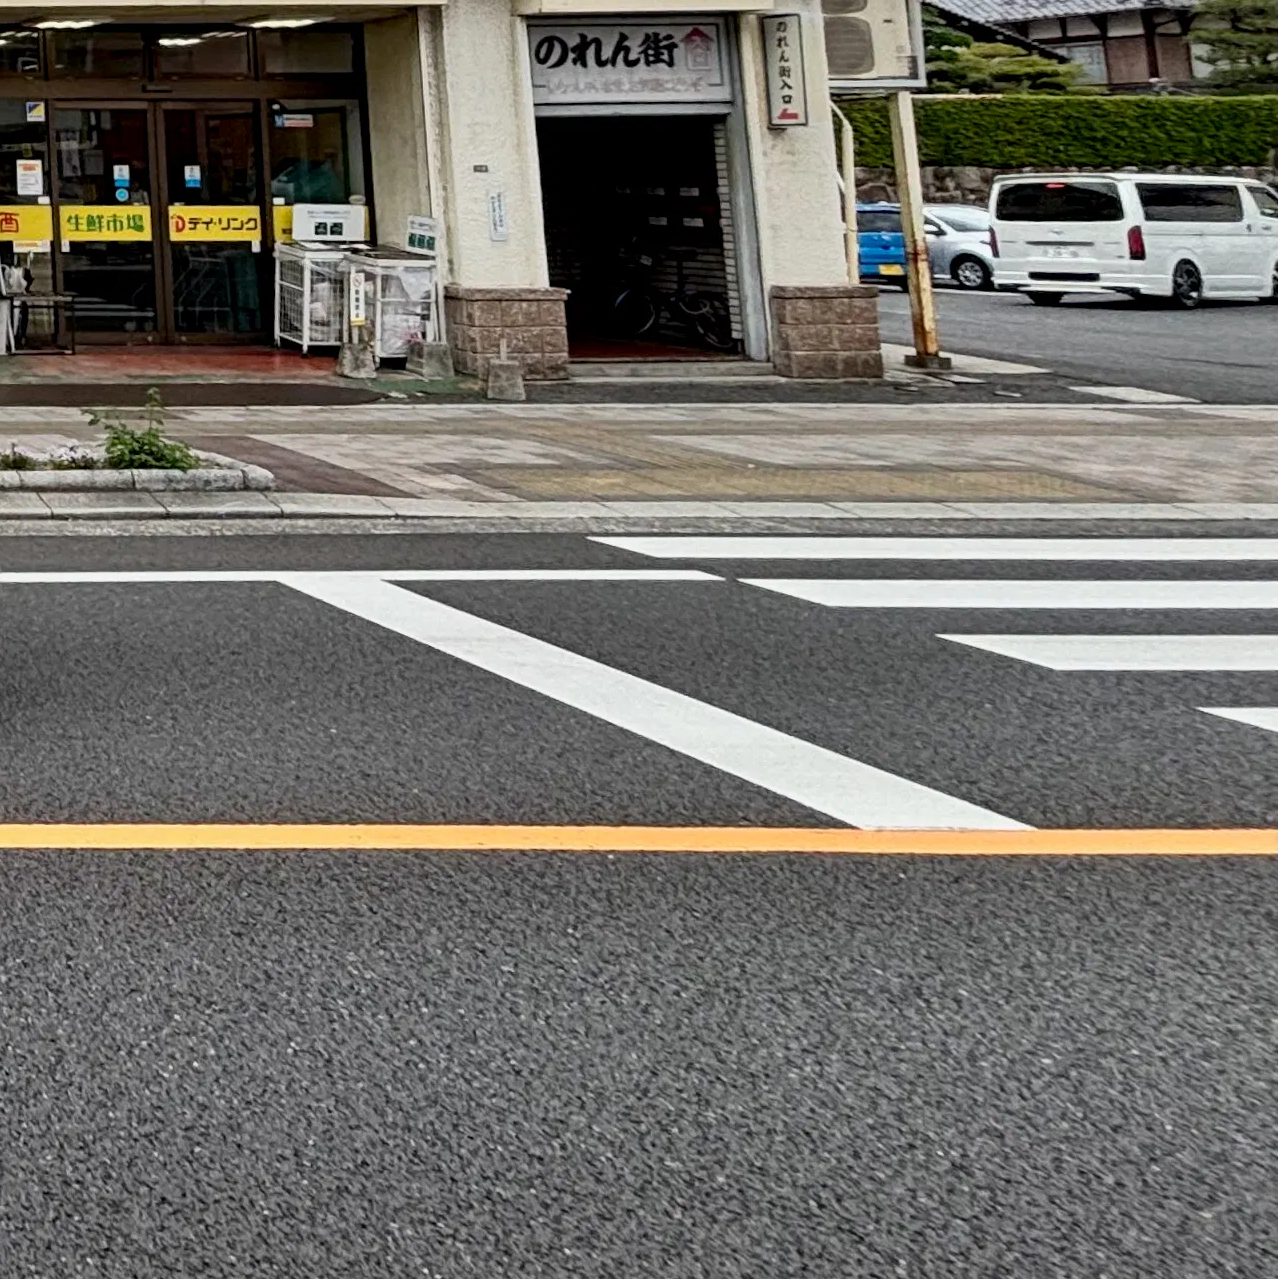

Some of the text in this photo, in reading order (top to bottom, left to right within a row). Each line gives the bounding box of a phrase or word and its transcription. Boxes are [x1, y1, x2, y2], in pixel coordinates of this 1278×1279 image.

[533, 31, 679, 69] のれん街
[775, 21, 793, 105] のれん街入口
[66, 212, 146, 233] 生鮮市場
[187, 216, 259, 232] デイ・リンク
